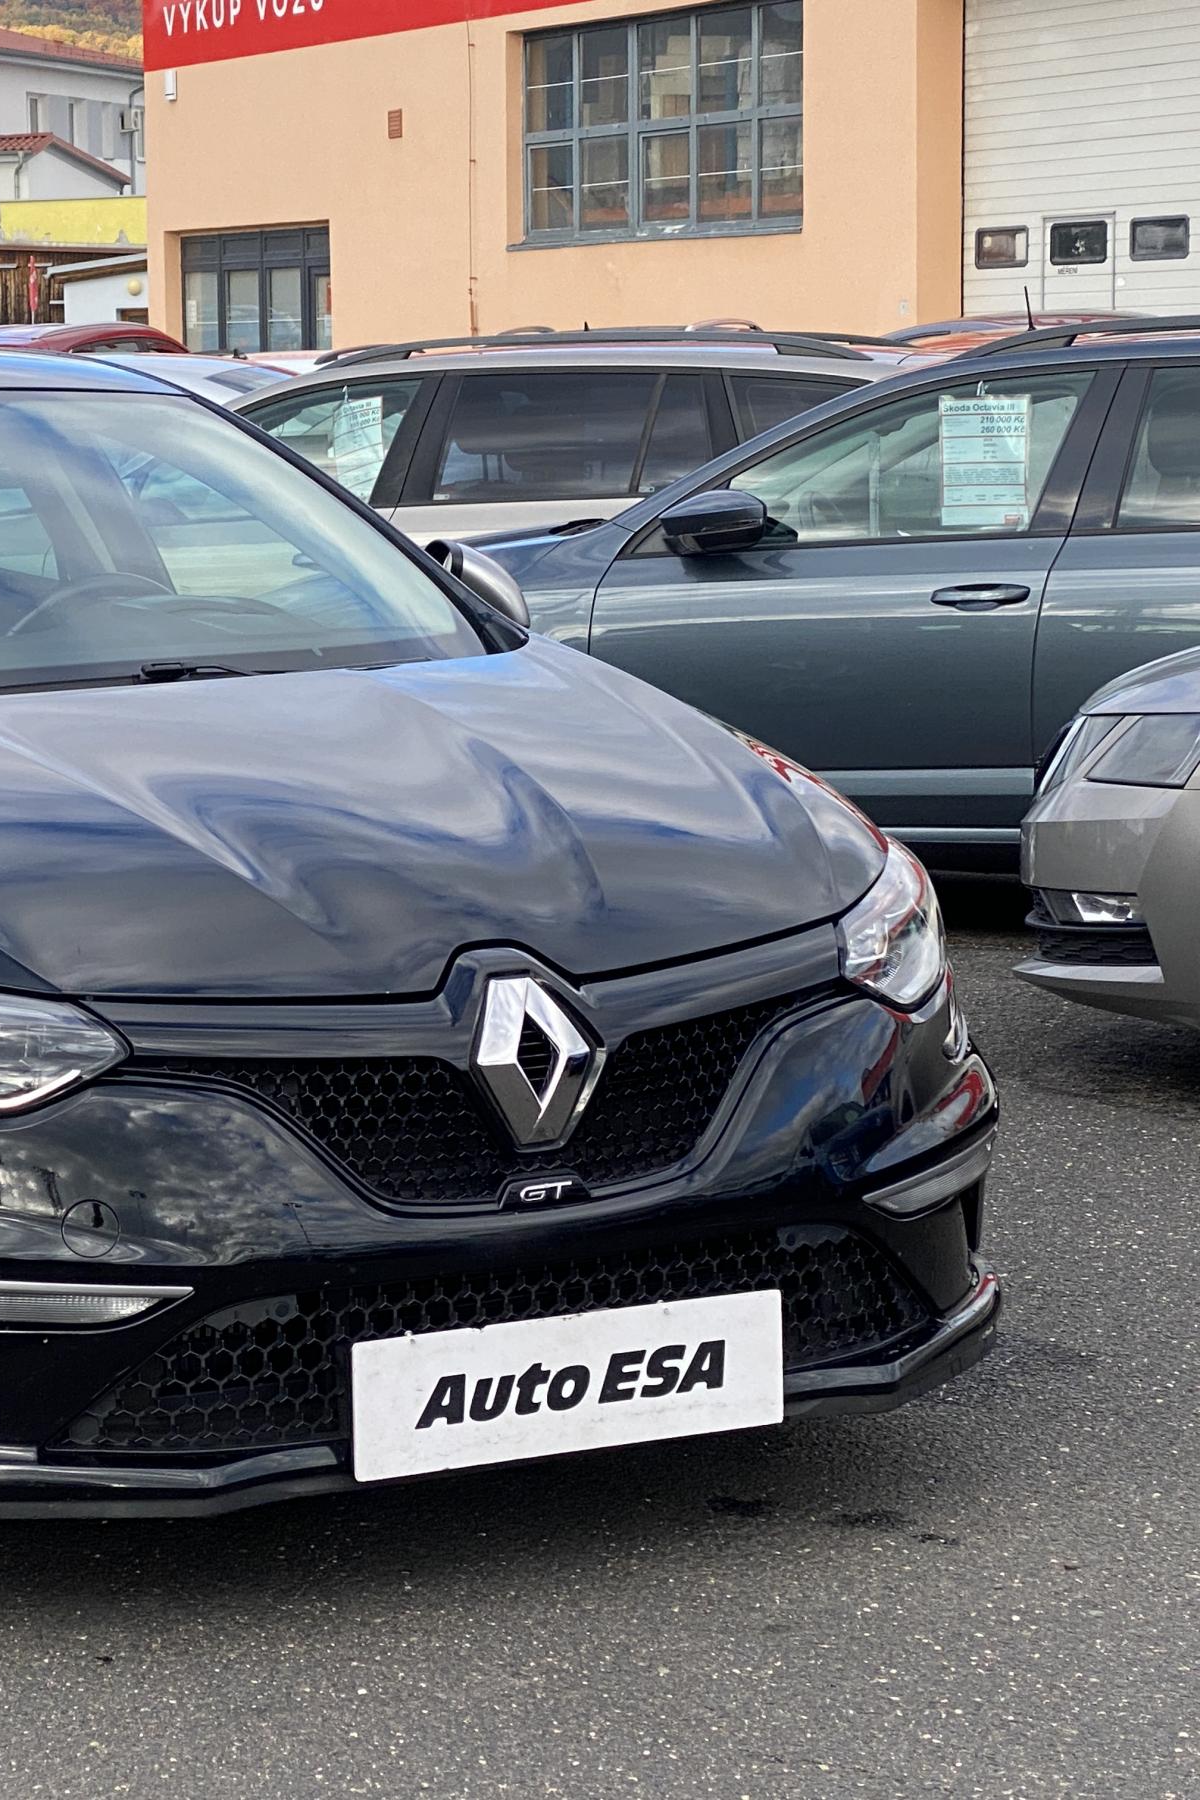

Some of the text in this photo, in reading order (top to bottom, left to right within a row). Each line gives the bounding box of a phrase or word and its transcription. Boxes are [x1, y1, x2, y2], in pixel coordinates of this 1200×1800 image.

[972, 402, 1005, 412] Octavia
[520, 1180, 573, 1202] GT
[415, 1339, 726, 1430] Auto ESA
